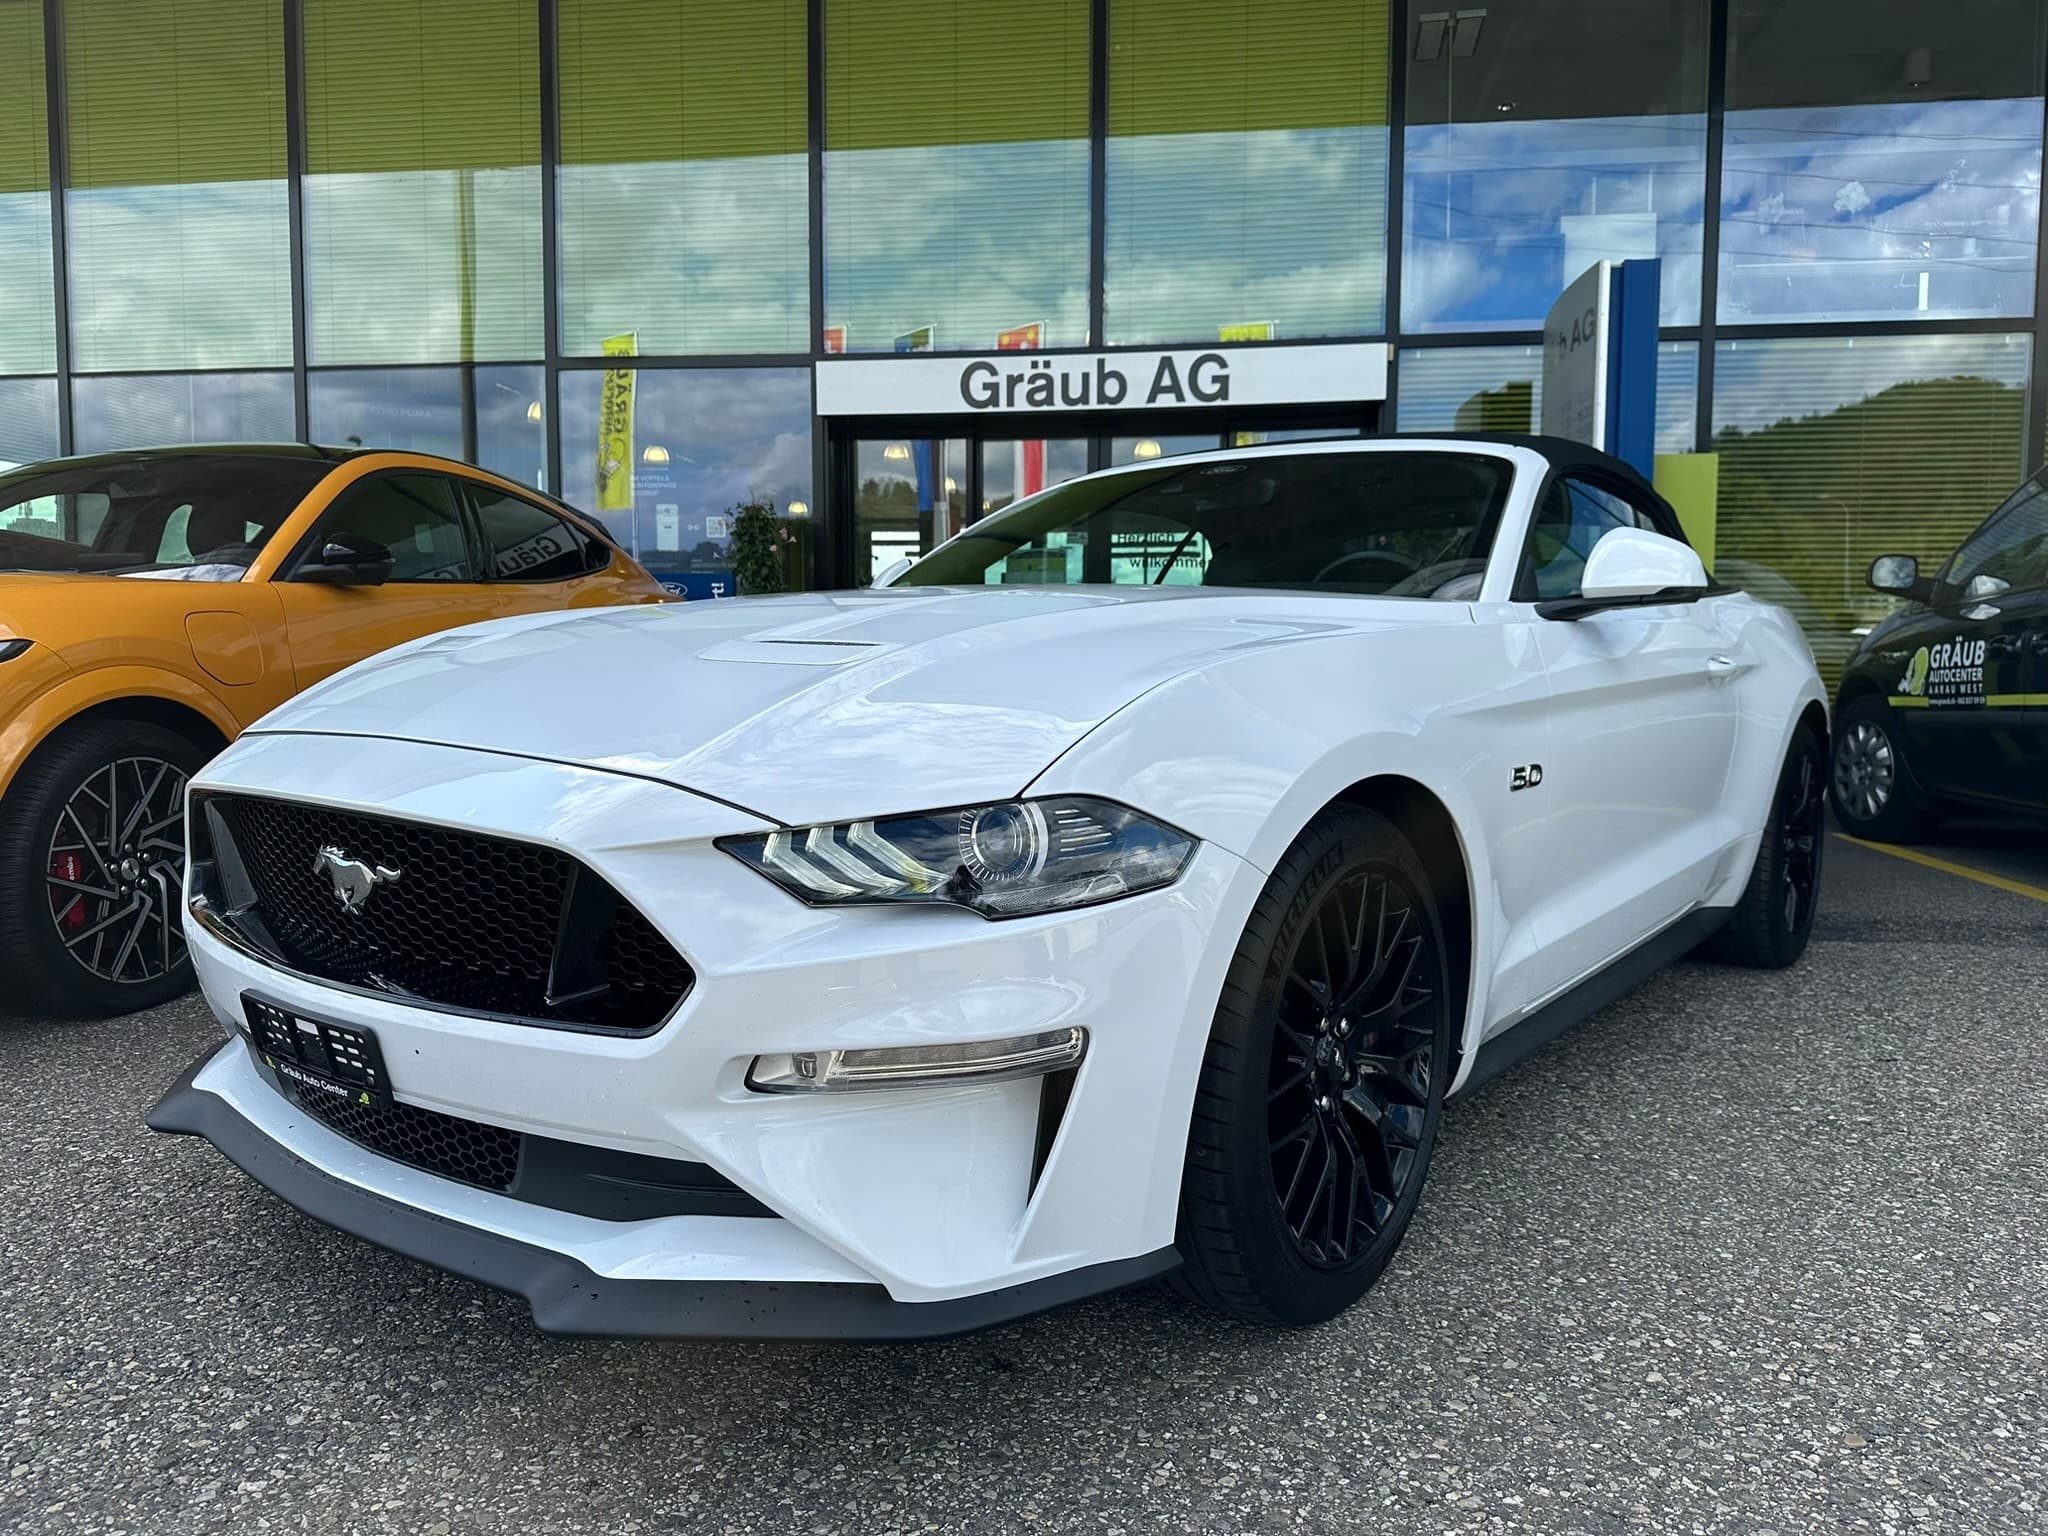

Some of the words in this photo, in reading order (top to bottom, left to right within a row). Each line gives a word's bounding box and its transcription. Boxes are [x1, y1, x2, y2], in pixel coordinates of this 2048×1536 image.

[960, 358, 1127, 409] Gräub
[1146, 354, 1230, 403] AG
[1930, 635, 1986, 669] GRÄUB
[1929, 667, 1983, 683] AUTOCENTER
[1960, 683, 1983, 693] WEST
[303, 1073, 321, 1088] Auto
[320, 1080, 349, 1097] Center
